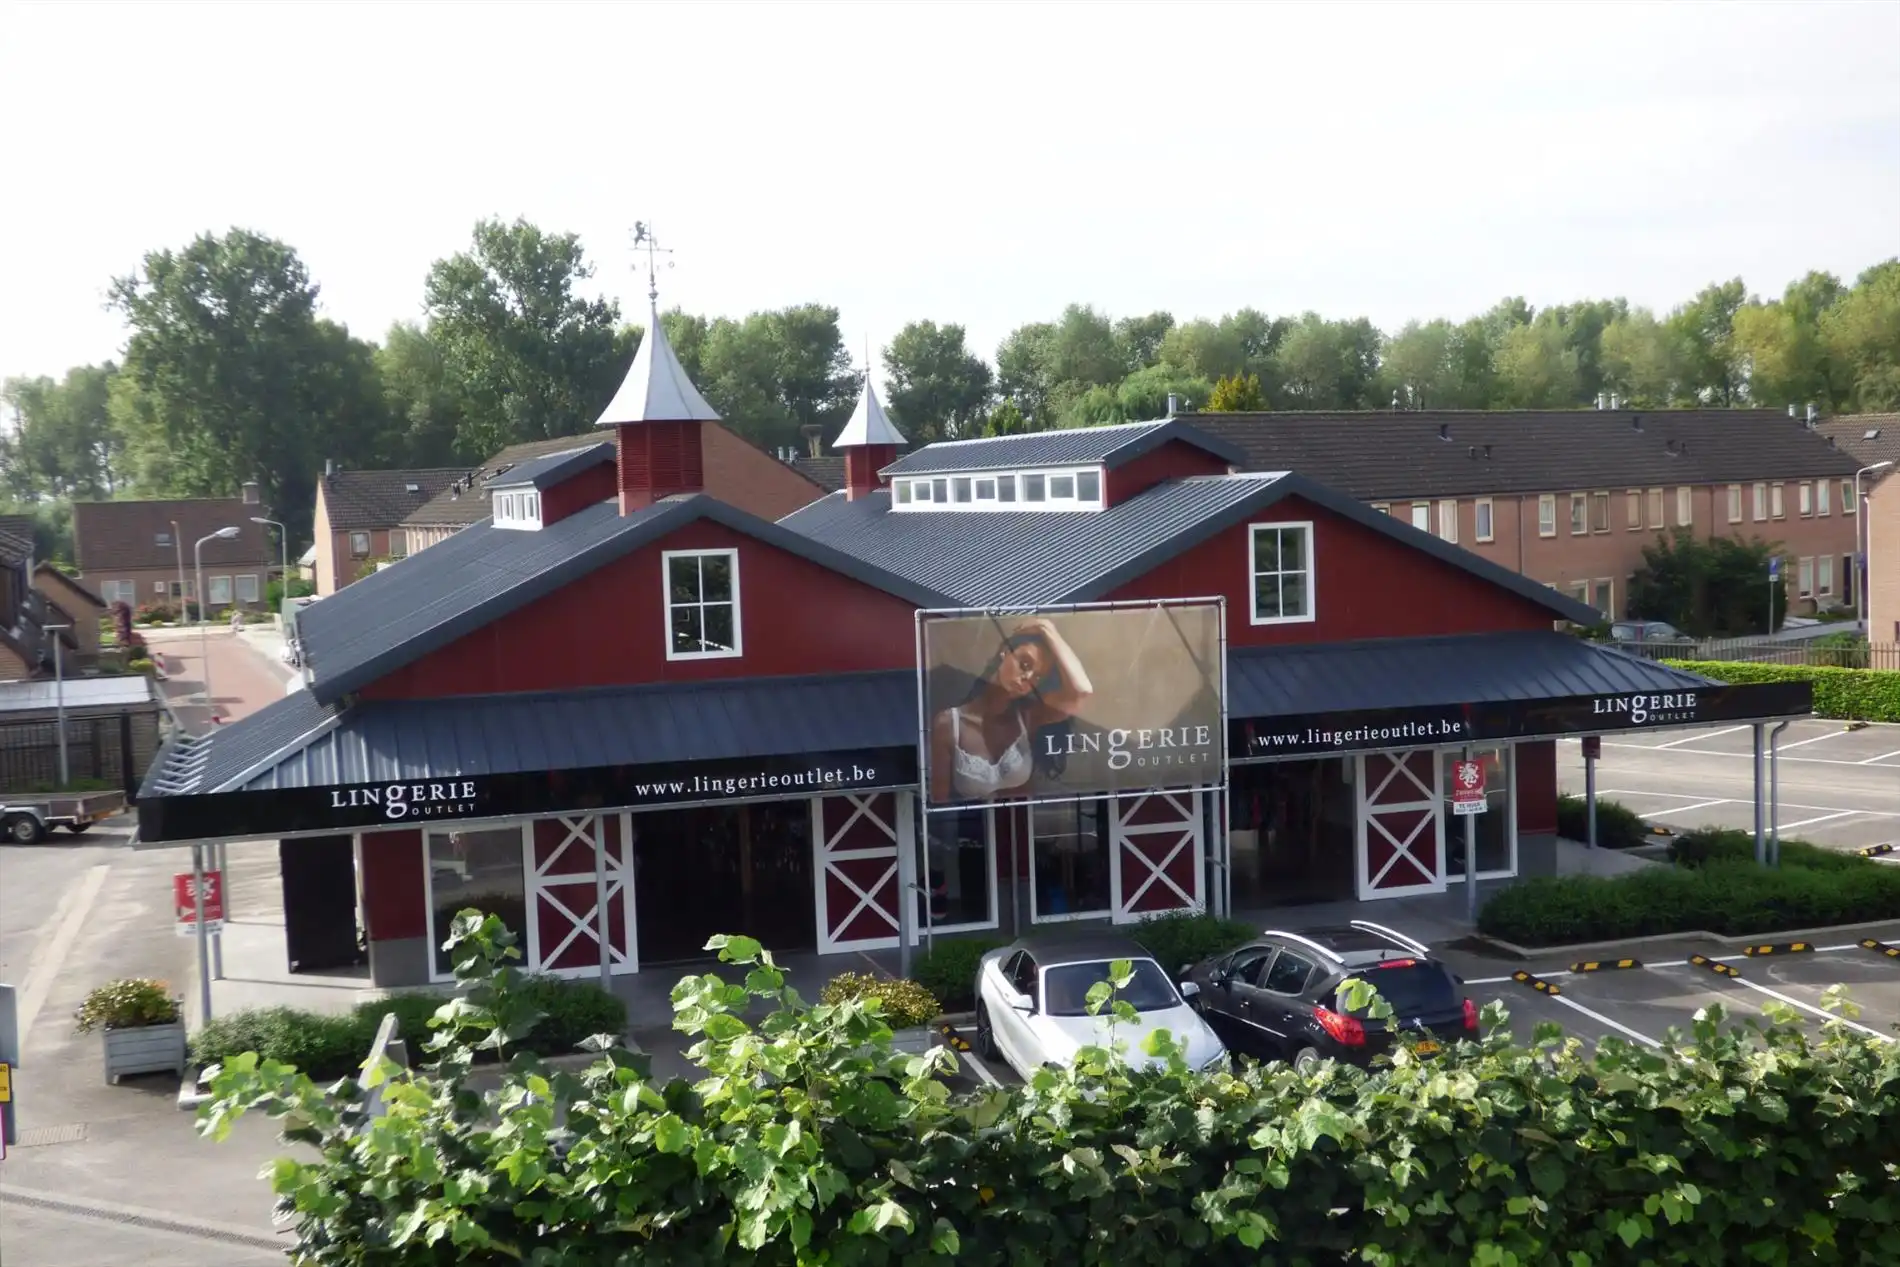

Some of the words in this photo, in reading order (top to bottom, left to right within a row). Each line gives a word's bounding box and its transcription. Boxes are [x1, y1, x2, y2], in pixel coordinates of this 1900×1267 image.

[1649, 711, 1696, 722] OUTLET
[1257, 719, 1461, 746] www.lingerieoutlet.be
[1137, 752, 1210, 767] OUTLET
[635, 765, 876, 795] www.lingerieoutlet.be
[411, 803, 475, 816] OUTLET
